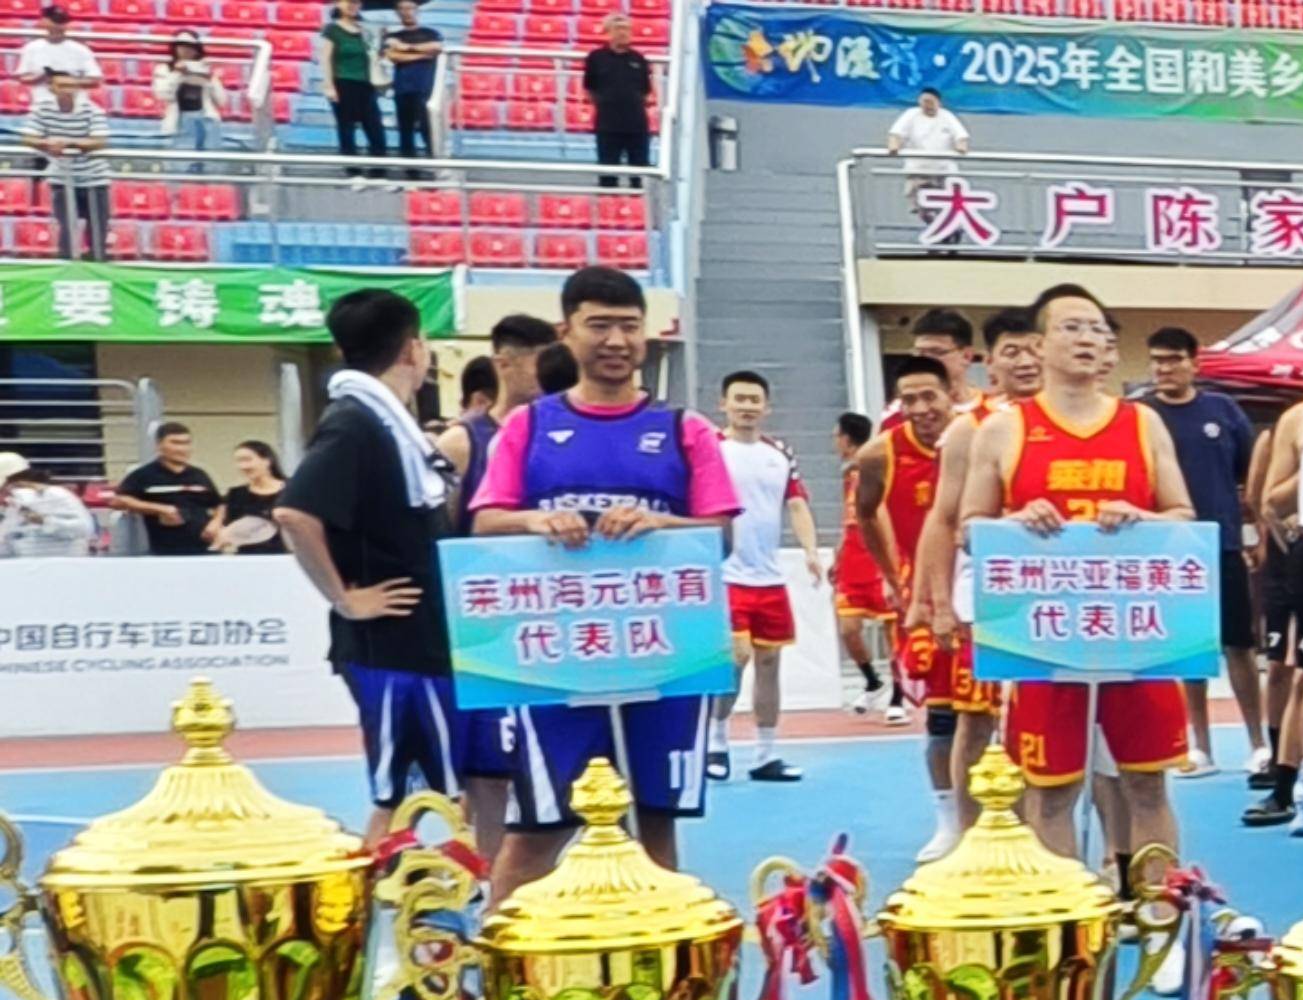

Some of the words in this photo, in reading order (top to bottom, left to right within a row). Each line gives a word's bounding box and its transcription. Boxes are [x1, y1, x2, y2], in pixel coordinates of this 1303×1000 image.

[460, 566, 712, 617] 莱州海元体育
[985, 556, 1208, 593] 莱州兴亚福黄金
[1029, 603, 1166, 640] 代表队
[516, 618, 675, 666] 代表队
[71, 657, 155, 672] CYCLING
[159, 653, 289, 670] ASSOCIATION
